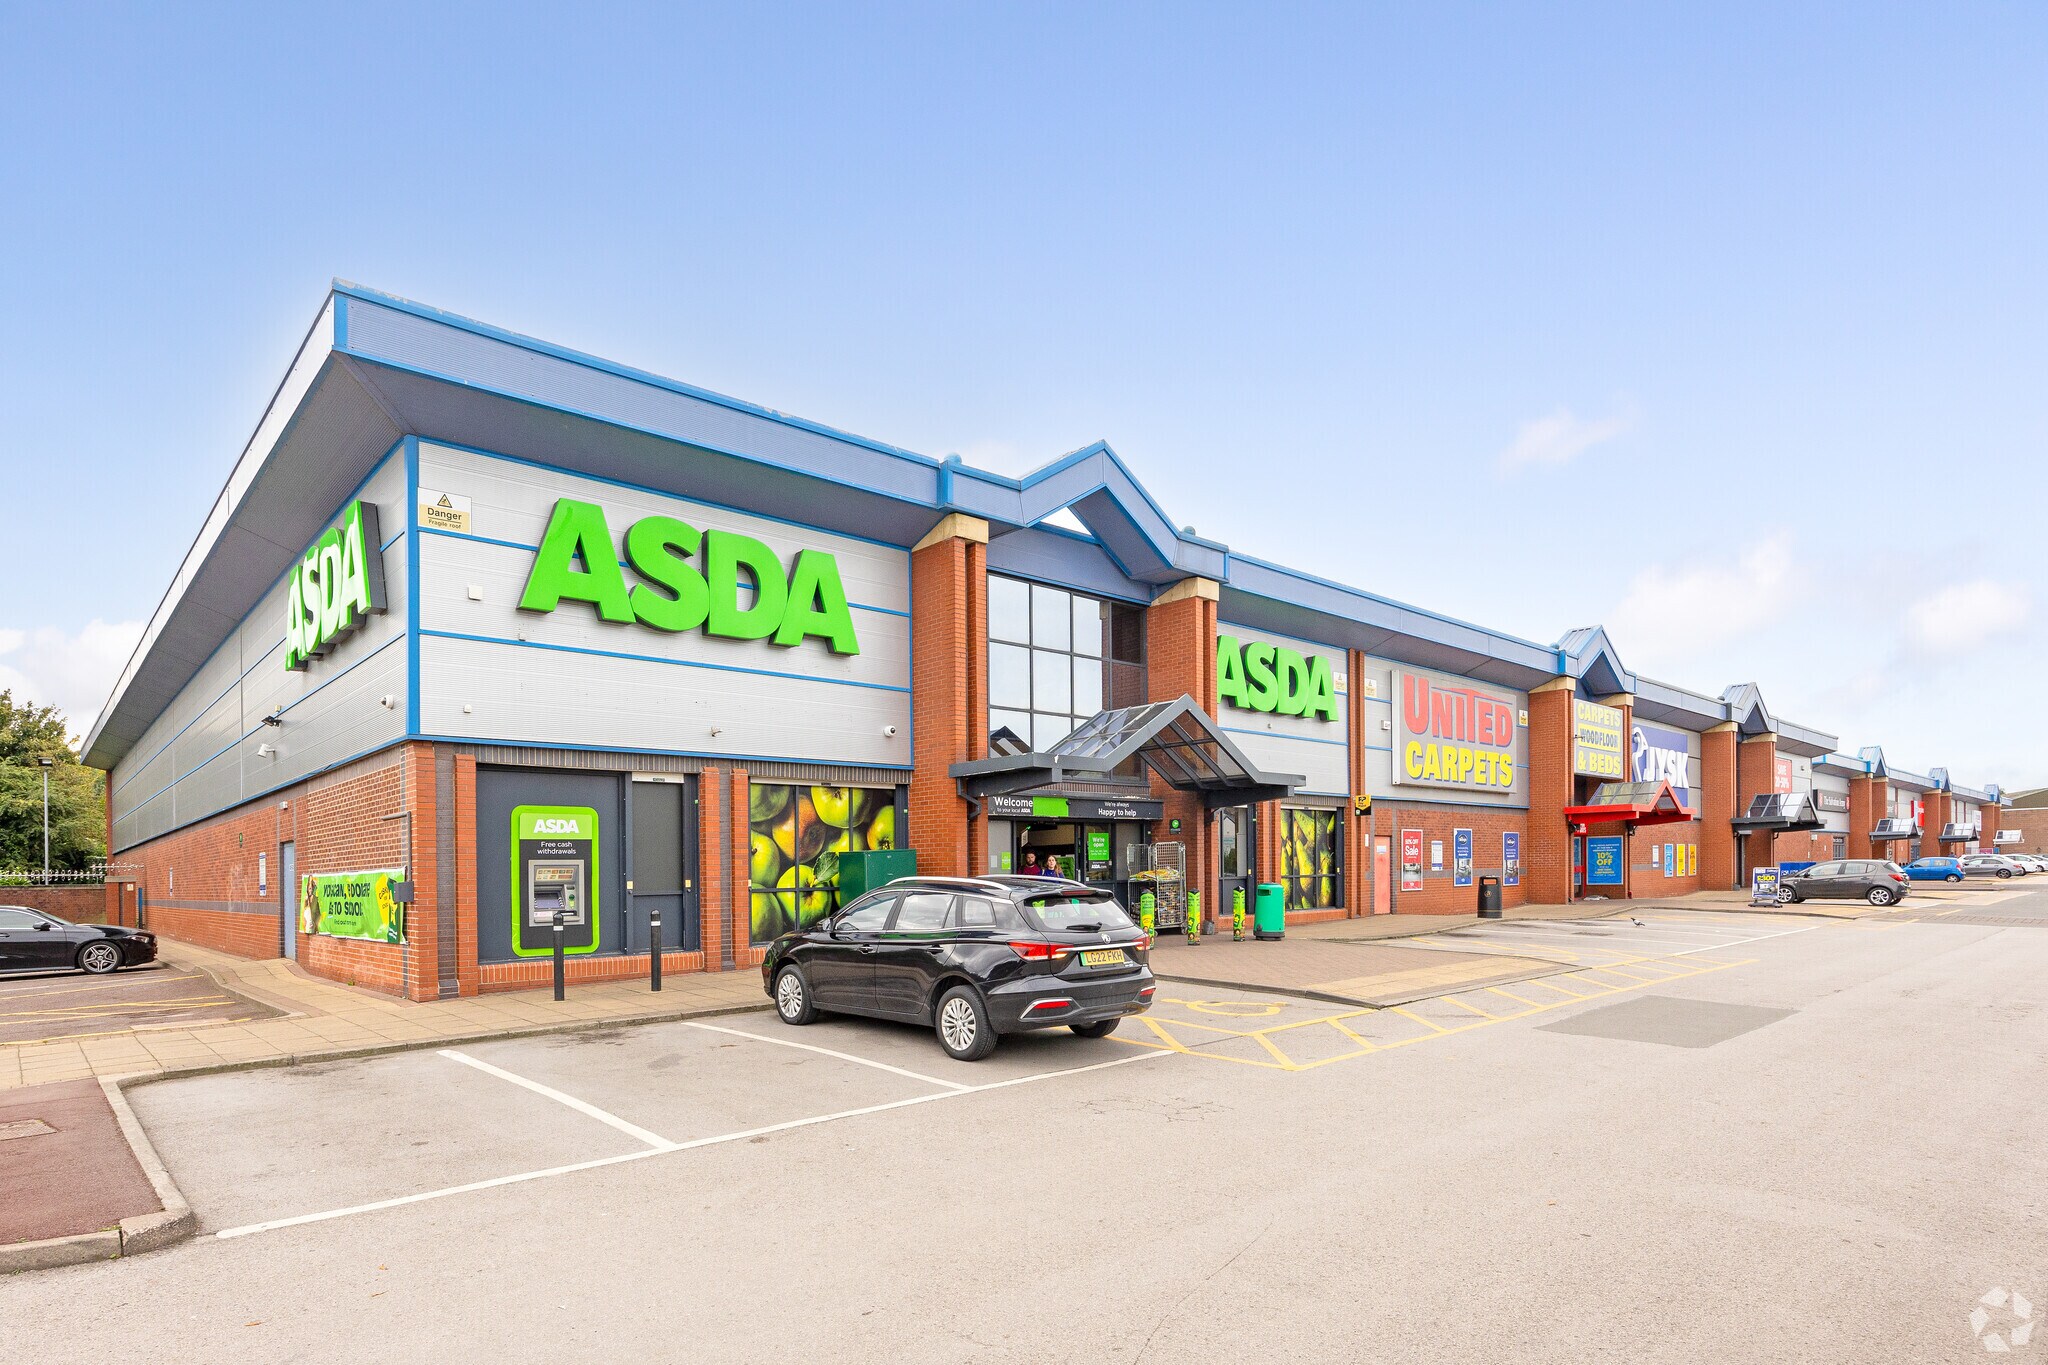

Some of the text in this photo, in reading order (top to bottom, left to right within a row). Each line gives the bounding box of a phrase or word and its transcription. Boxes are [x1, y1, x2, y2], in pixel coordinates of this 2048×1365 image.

[427, 507, 462, 521] Danger
[428, 518, 448, 527] Fragile
[516, 498, 860, 656] ASDA
[285, 499, 373, 672] ASDA
[1217, 634, 1339, 722] ASDA
[1577, 702, 1620, 728] CARPETS
[1405, 740, 1513, 788] CARPETS
[1577, 750, 1620, 775] & BEDS
[1643, 746, 1689, 789] JYSK
[994, 796, 1034, 807] Welcome
[1098, 808, 1116, 817] Happy
[1124, 809, 1137, 817] help
[533, 818, 580, 834] ASDA
[1404, 844, 1419, 856] Sale
[1597, 851, 1613, 859] 10%
[1086, 952, 1107, 963] LG22
